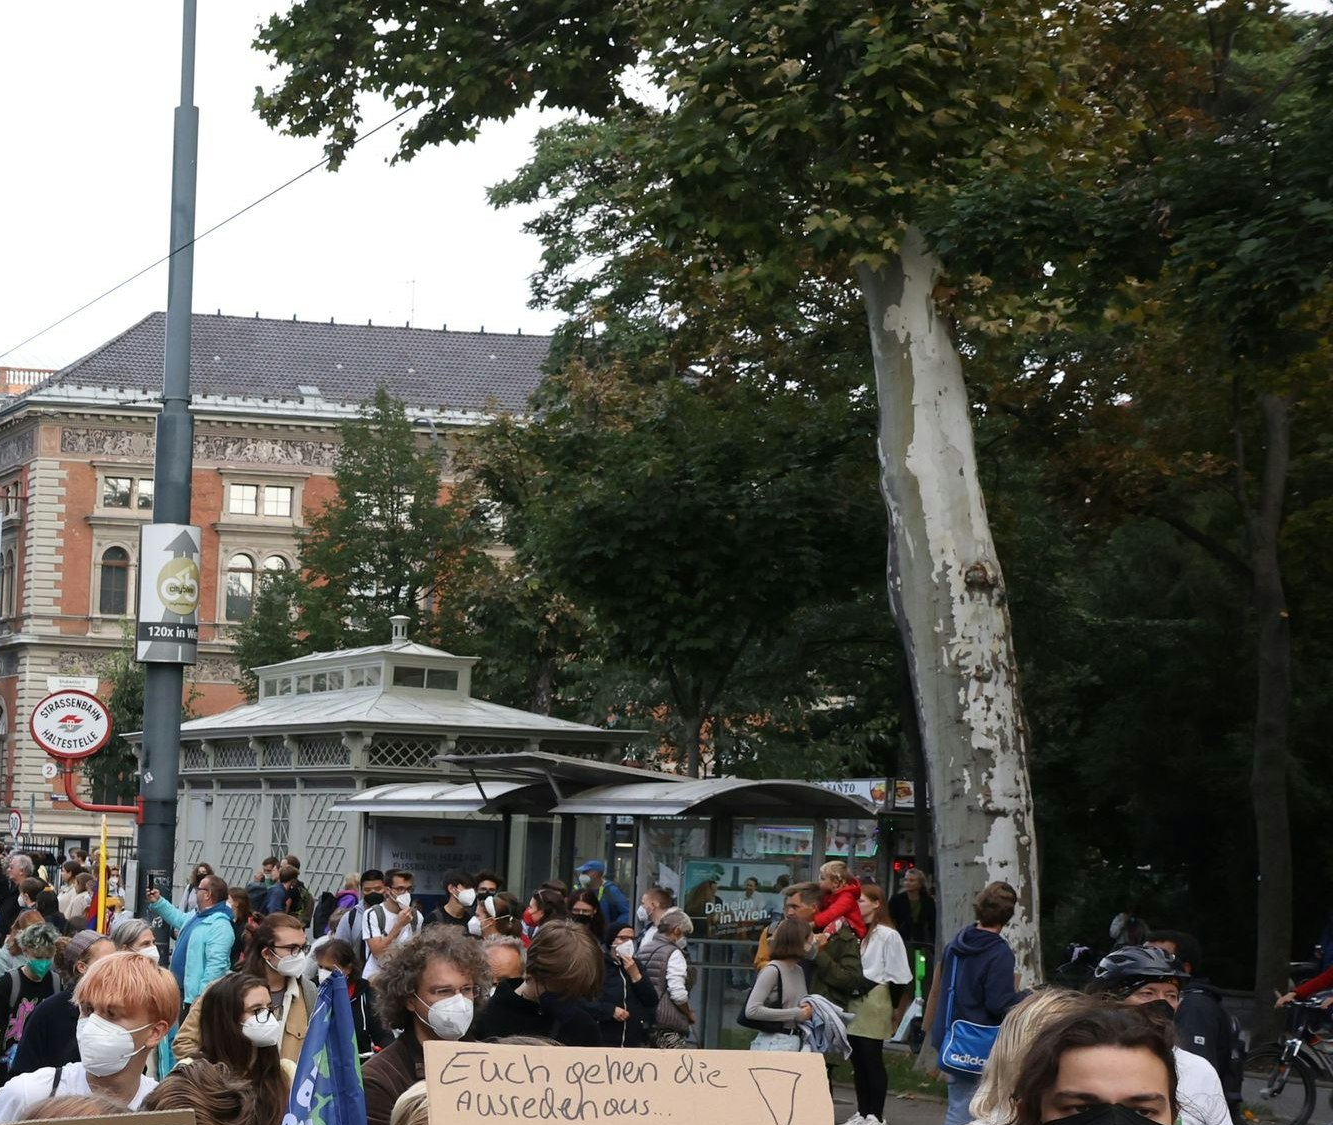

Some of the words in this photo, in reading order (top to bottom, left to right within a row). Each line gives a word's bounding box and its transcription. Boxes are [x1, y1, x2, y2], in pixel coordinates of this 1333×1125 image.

[148, 626, 173, 637] 120x
[176, 626, 185, 637] in
[40, 698, 102, 721] STRASSENBAHN
[42, 729, 98, 748] HALTESTELLE
[11, 817, 18, 830] 30
[705, 899, 753, 914] Daheim
[720, 913, 731, 924] in
[734, 910, 771, 921] Wien.
[951, 1054, 986, 1066] adida
[440, 1051, 550, 1086] Euch
[566, 1053, 658, 1101] gehen
[674, 1054, 728, 1088] die
